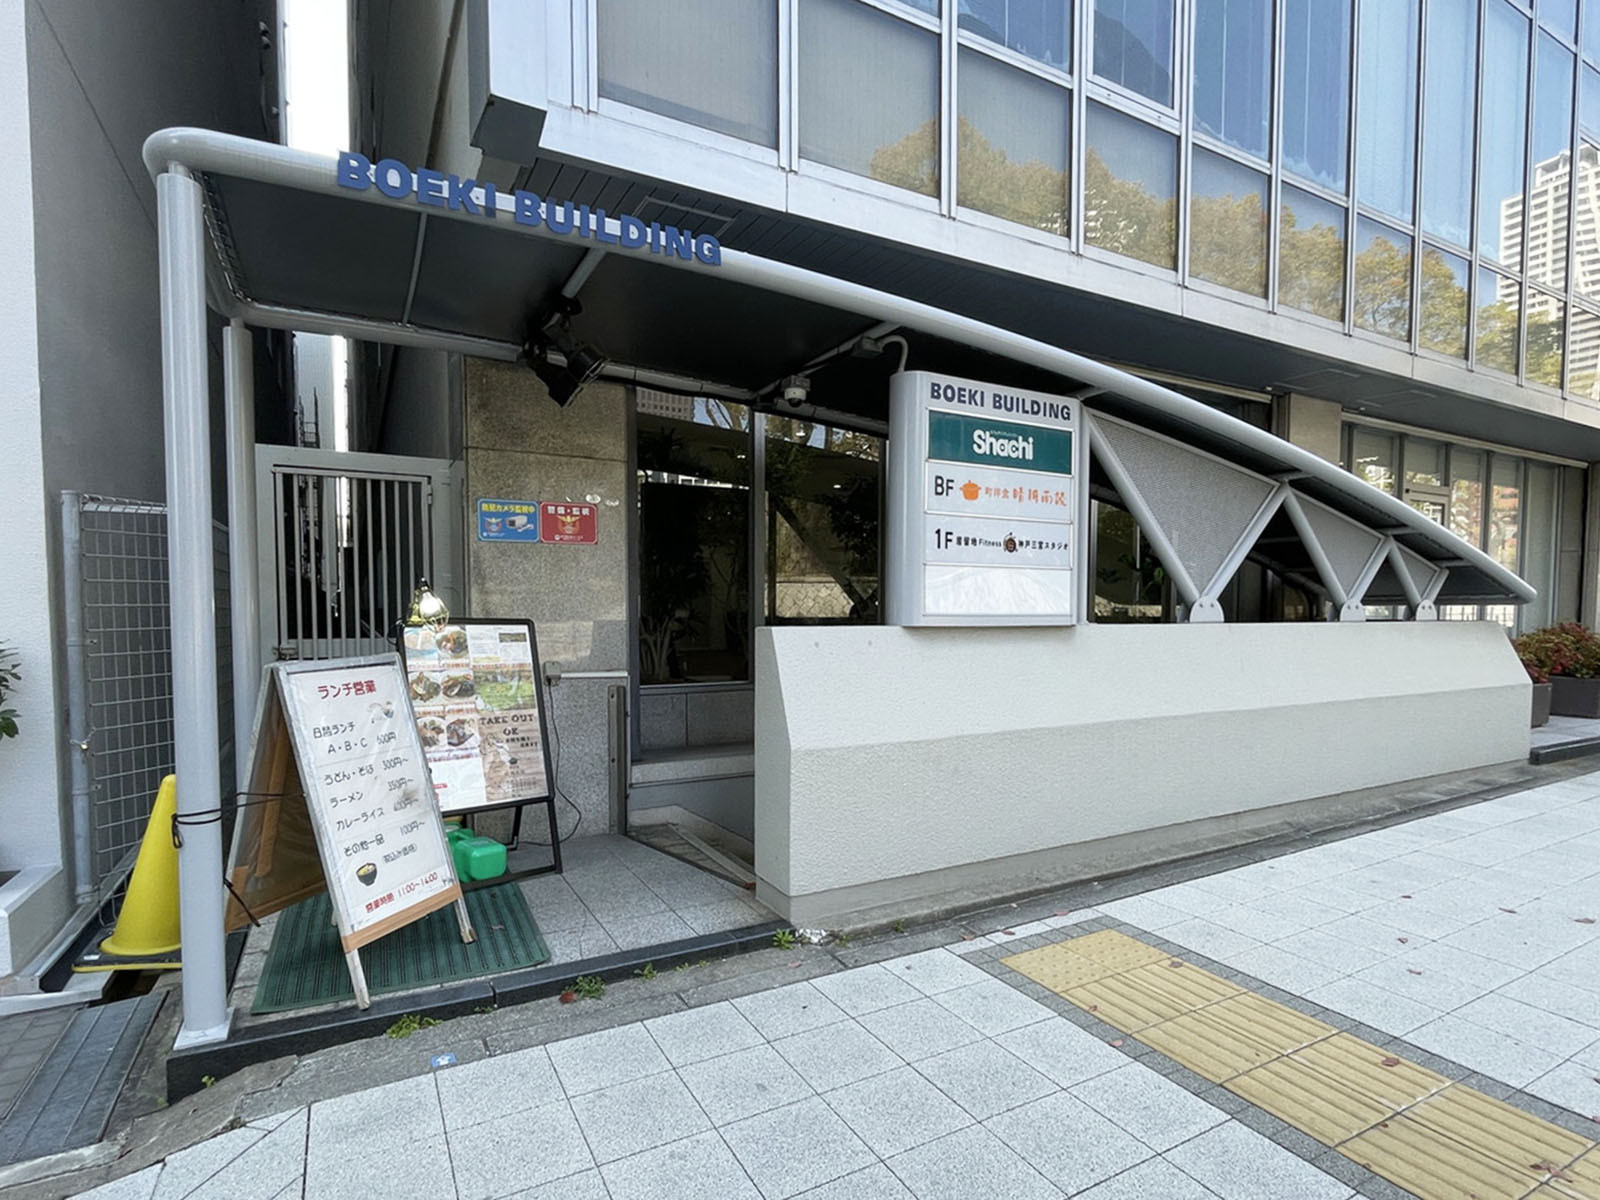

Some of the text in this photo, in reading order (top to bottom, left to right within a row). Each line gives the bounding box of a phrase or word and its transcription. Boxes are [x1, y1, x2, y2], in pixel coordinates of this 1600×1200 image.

[337, 150, 722, 266] BOEKI BUILDING
[930, 382, 1071, 421] BOEKI BUILDING
[973, 429, 1034, 460] Shachi
[934, 475, 954, 496] BF
[935, 528, 953, 549] 1F
[979, 538, 1002, 548] Fitness
[317, 680, 377, 700] ランチ営業
[480, 713, 535, 726] TAKE OUT
[503, 727, 519, 736] OK
[330, 791, 364, 808] ラーメン
[336, 807, 385, 831] カレーライス
